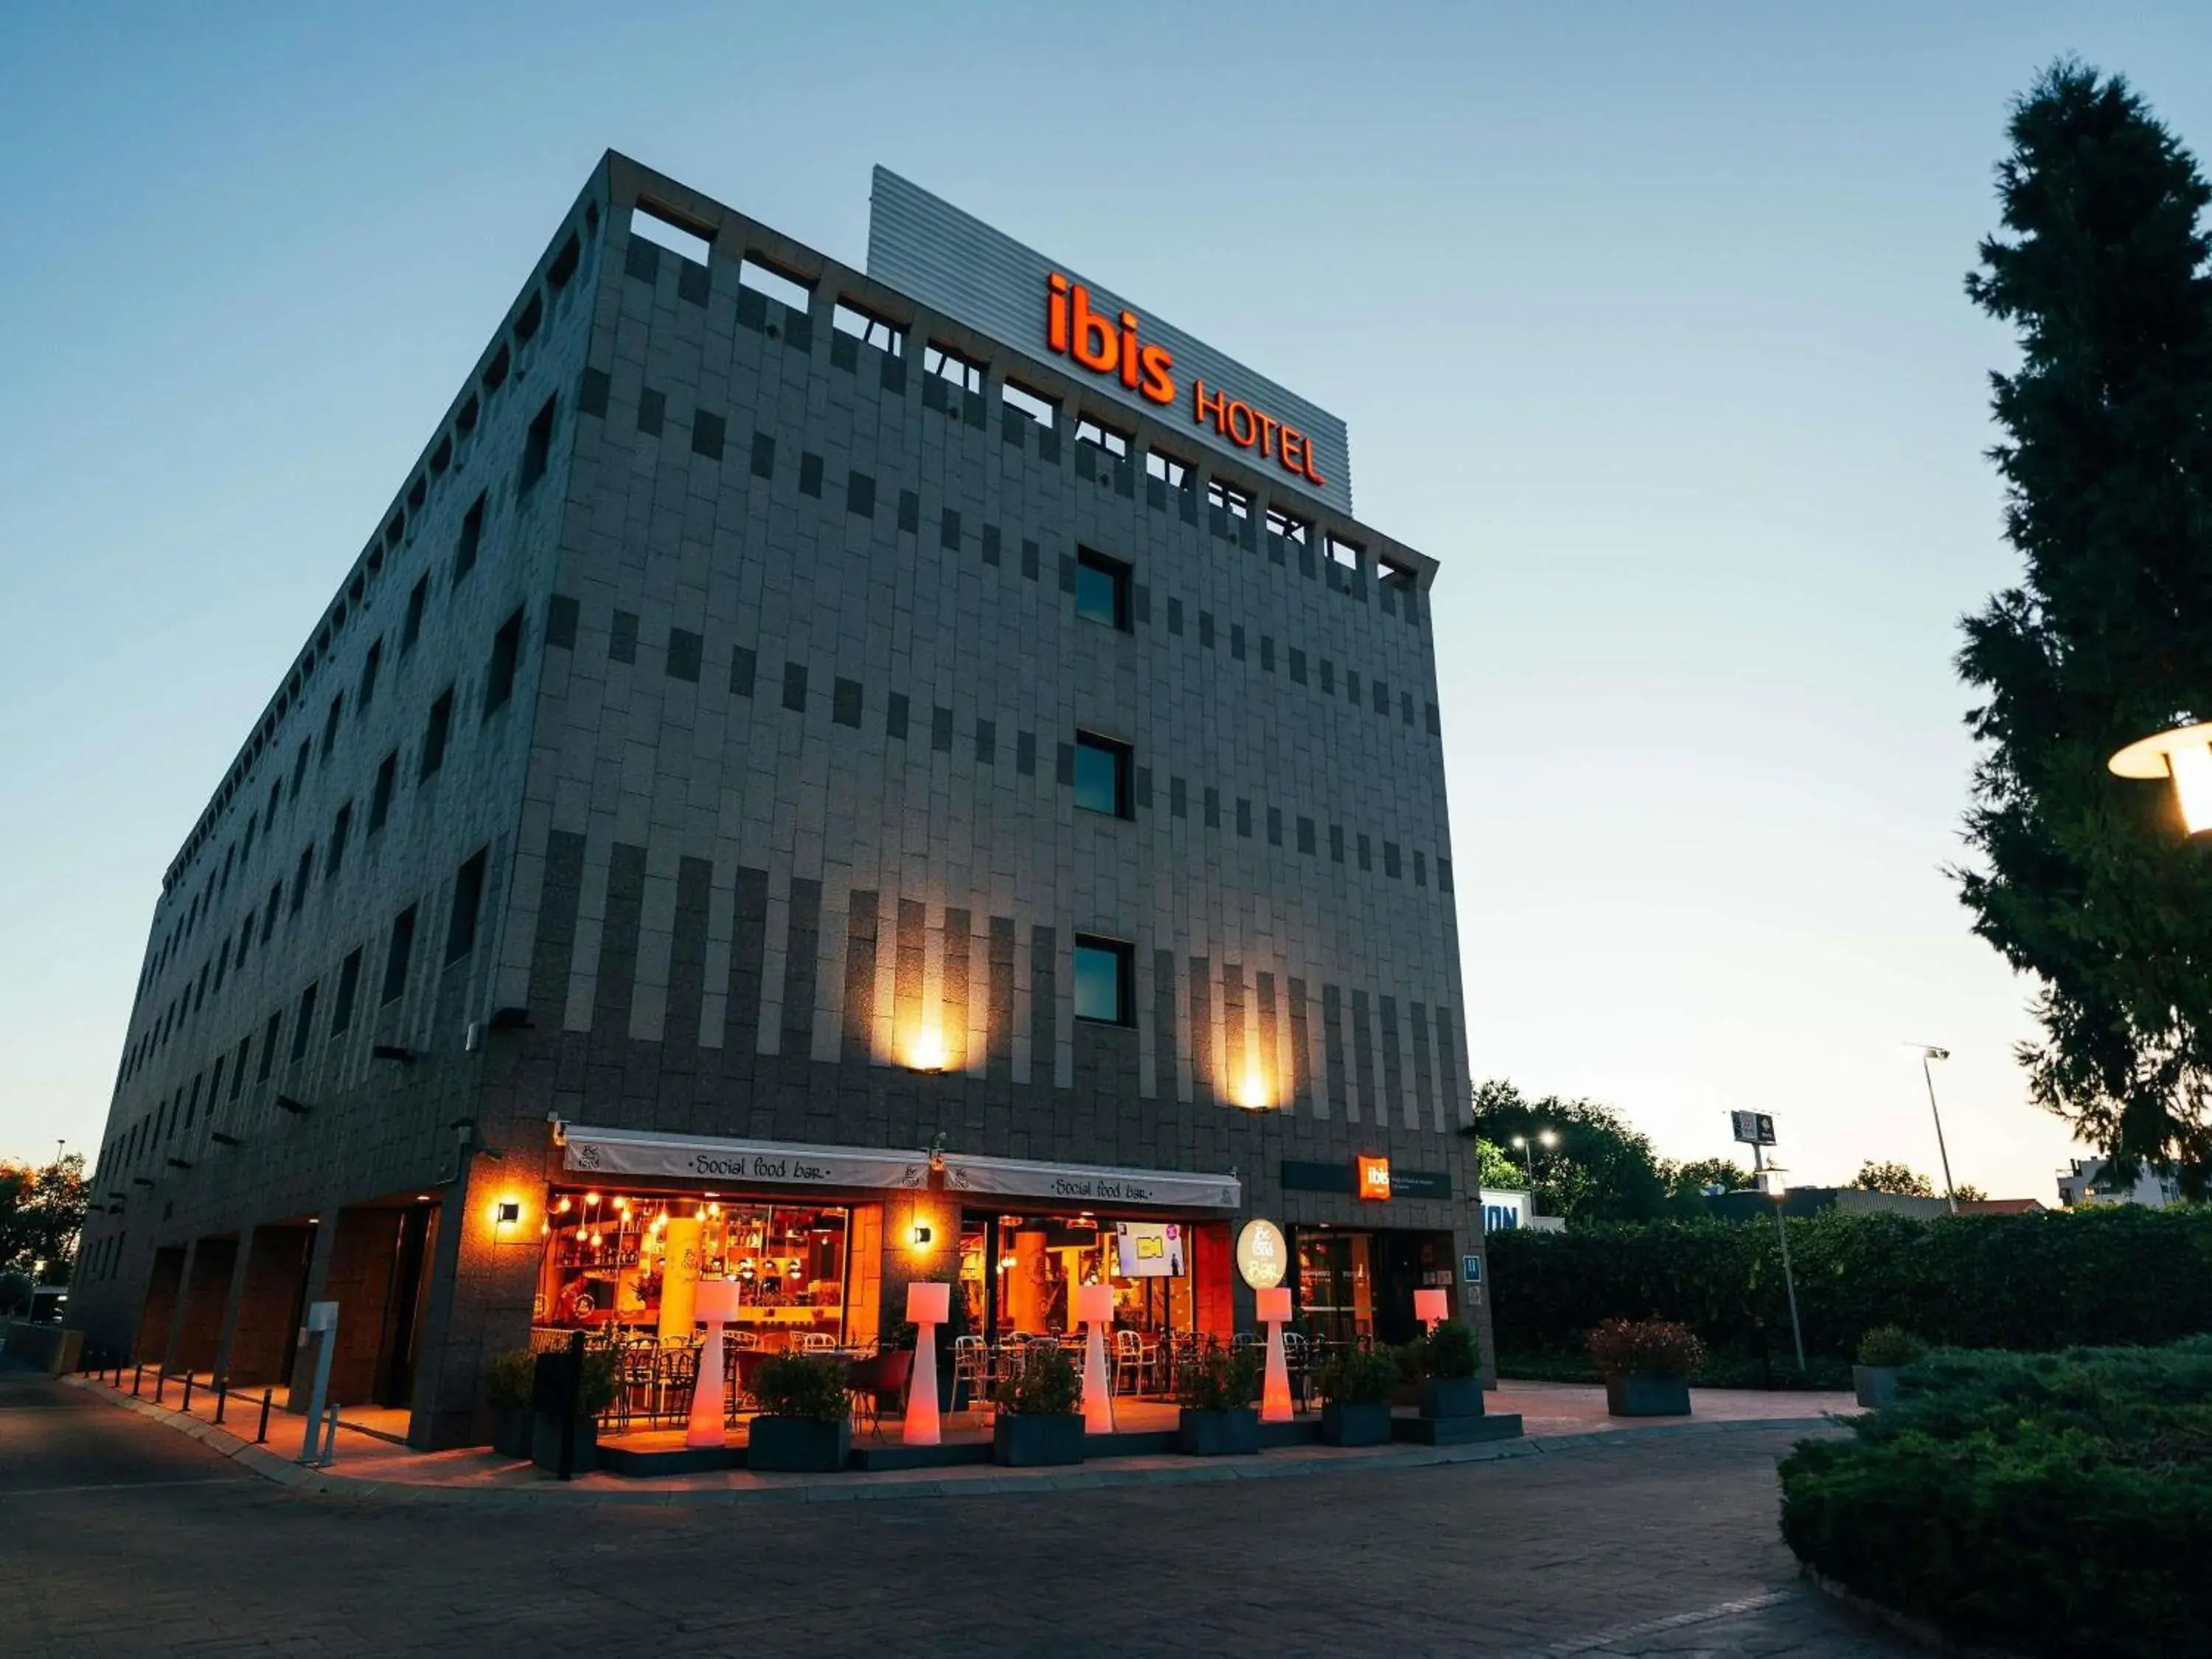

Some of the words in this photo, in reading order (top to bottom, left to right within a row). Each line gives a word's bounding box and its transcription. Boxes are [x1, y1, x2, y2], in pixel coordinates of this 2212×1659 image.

[1047, 271, 1176, 405] ibis
[1194, 379, 1325, 485] HOTEL
[697, 1155, 745, 1175] Social
[754, 1157, 785, 1178] food
[1368, 1167, 1390, 1185] ibis
[1057, 1179, 1091, 1196] Social
[1097, 1180, 1120, 1198] food
